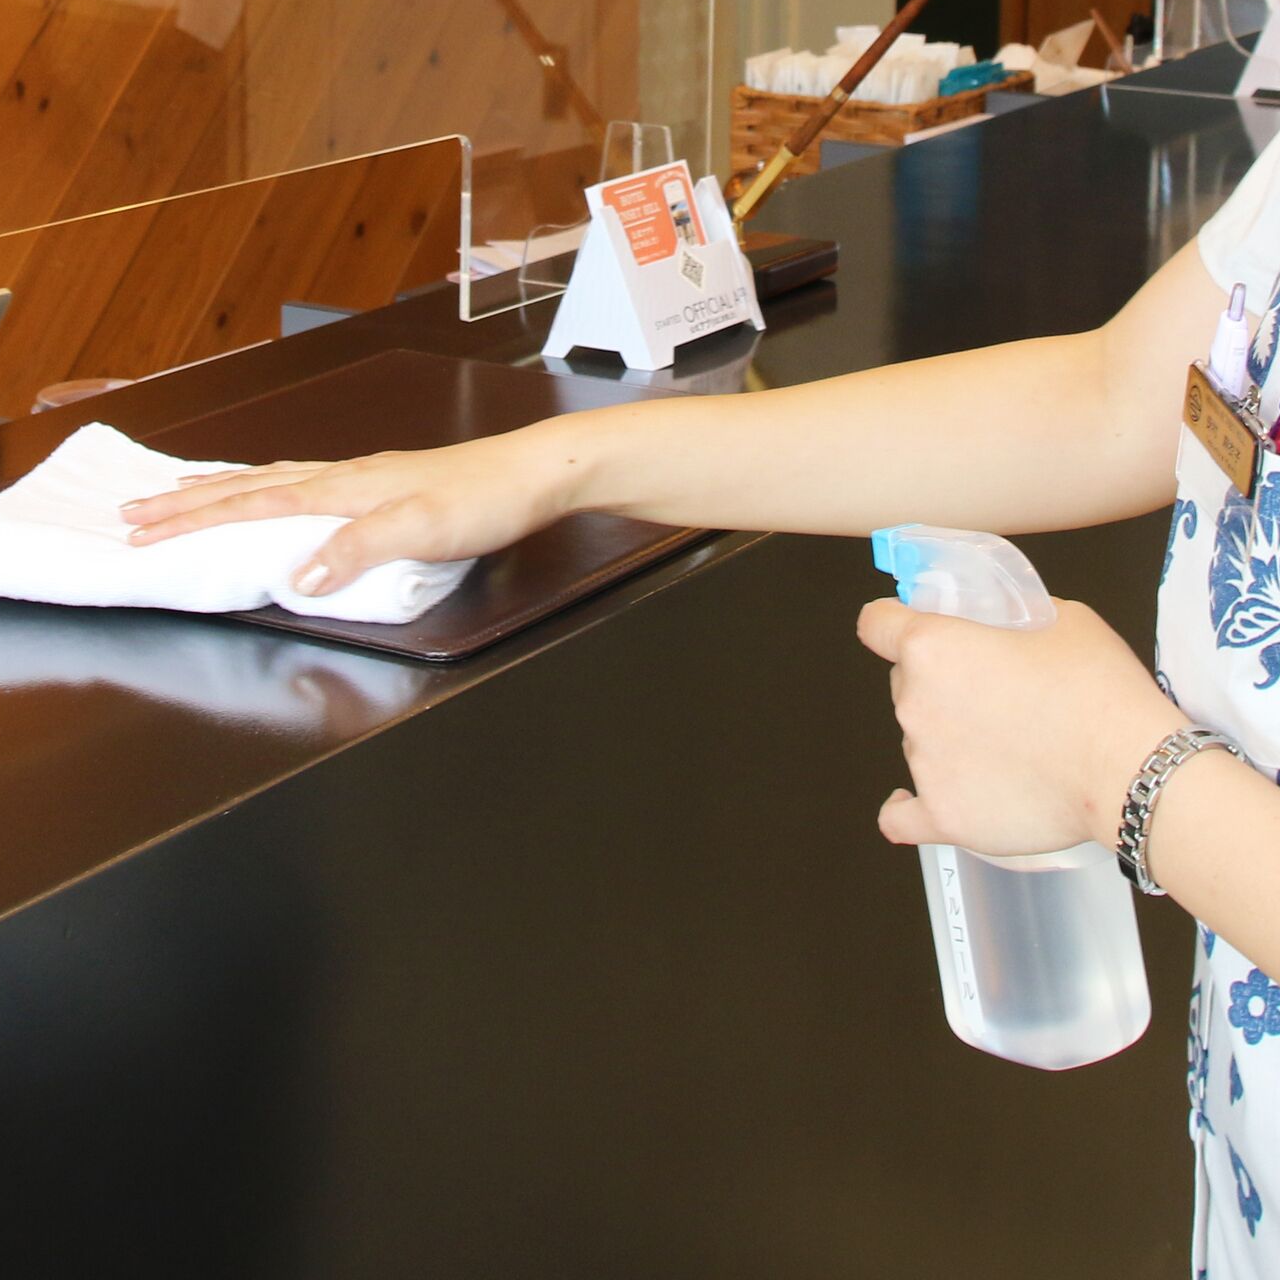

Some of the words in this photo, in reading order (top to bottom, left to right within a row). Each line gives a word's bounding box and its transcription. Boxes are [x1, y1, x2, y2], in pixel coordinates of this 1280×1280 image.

[943, 867, 975, 1001] アルコール
